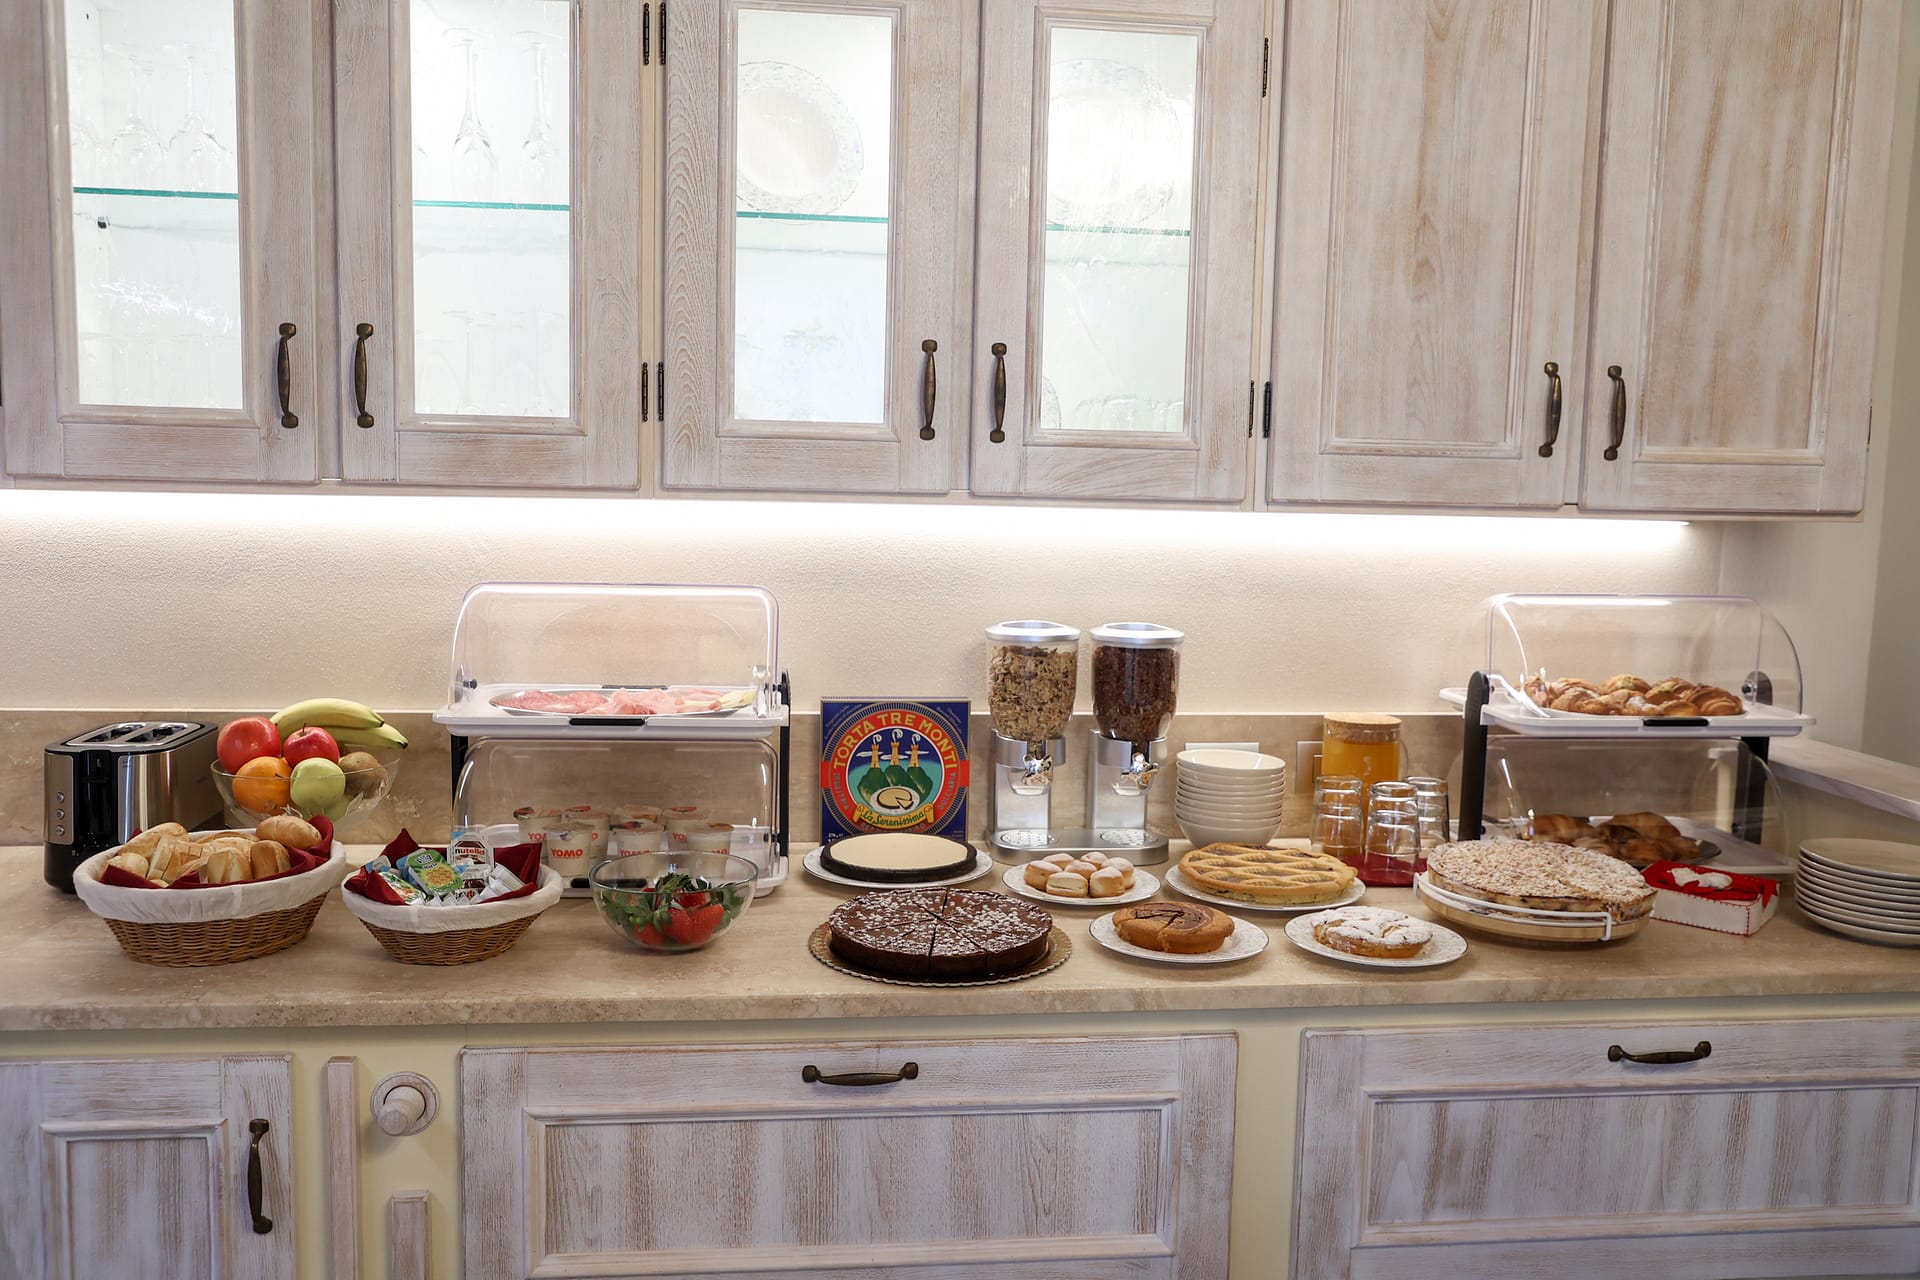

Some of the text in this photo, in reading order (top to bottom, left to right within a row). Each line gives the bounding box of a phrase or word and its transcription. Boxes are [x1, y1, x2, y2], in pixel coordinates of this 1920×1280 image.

[834, 722, 875, 768] TORTA
[877, 712, 916, 727] TRE
[918, 719, 958, 768] MONTI
[861, 809, 873, 822] La
[528, 832, 547, 841] YO
[672, 833, 687, 842] YO
[551, 848, 583, 857] YOMO
